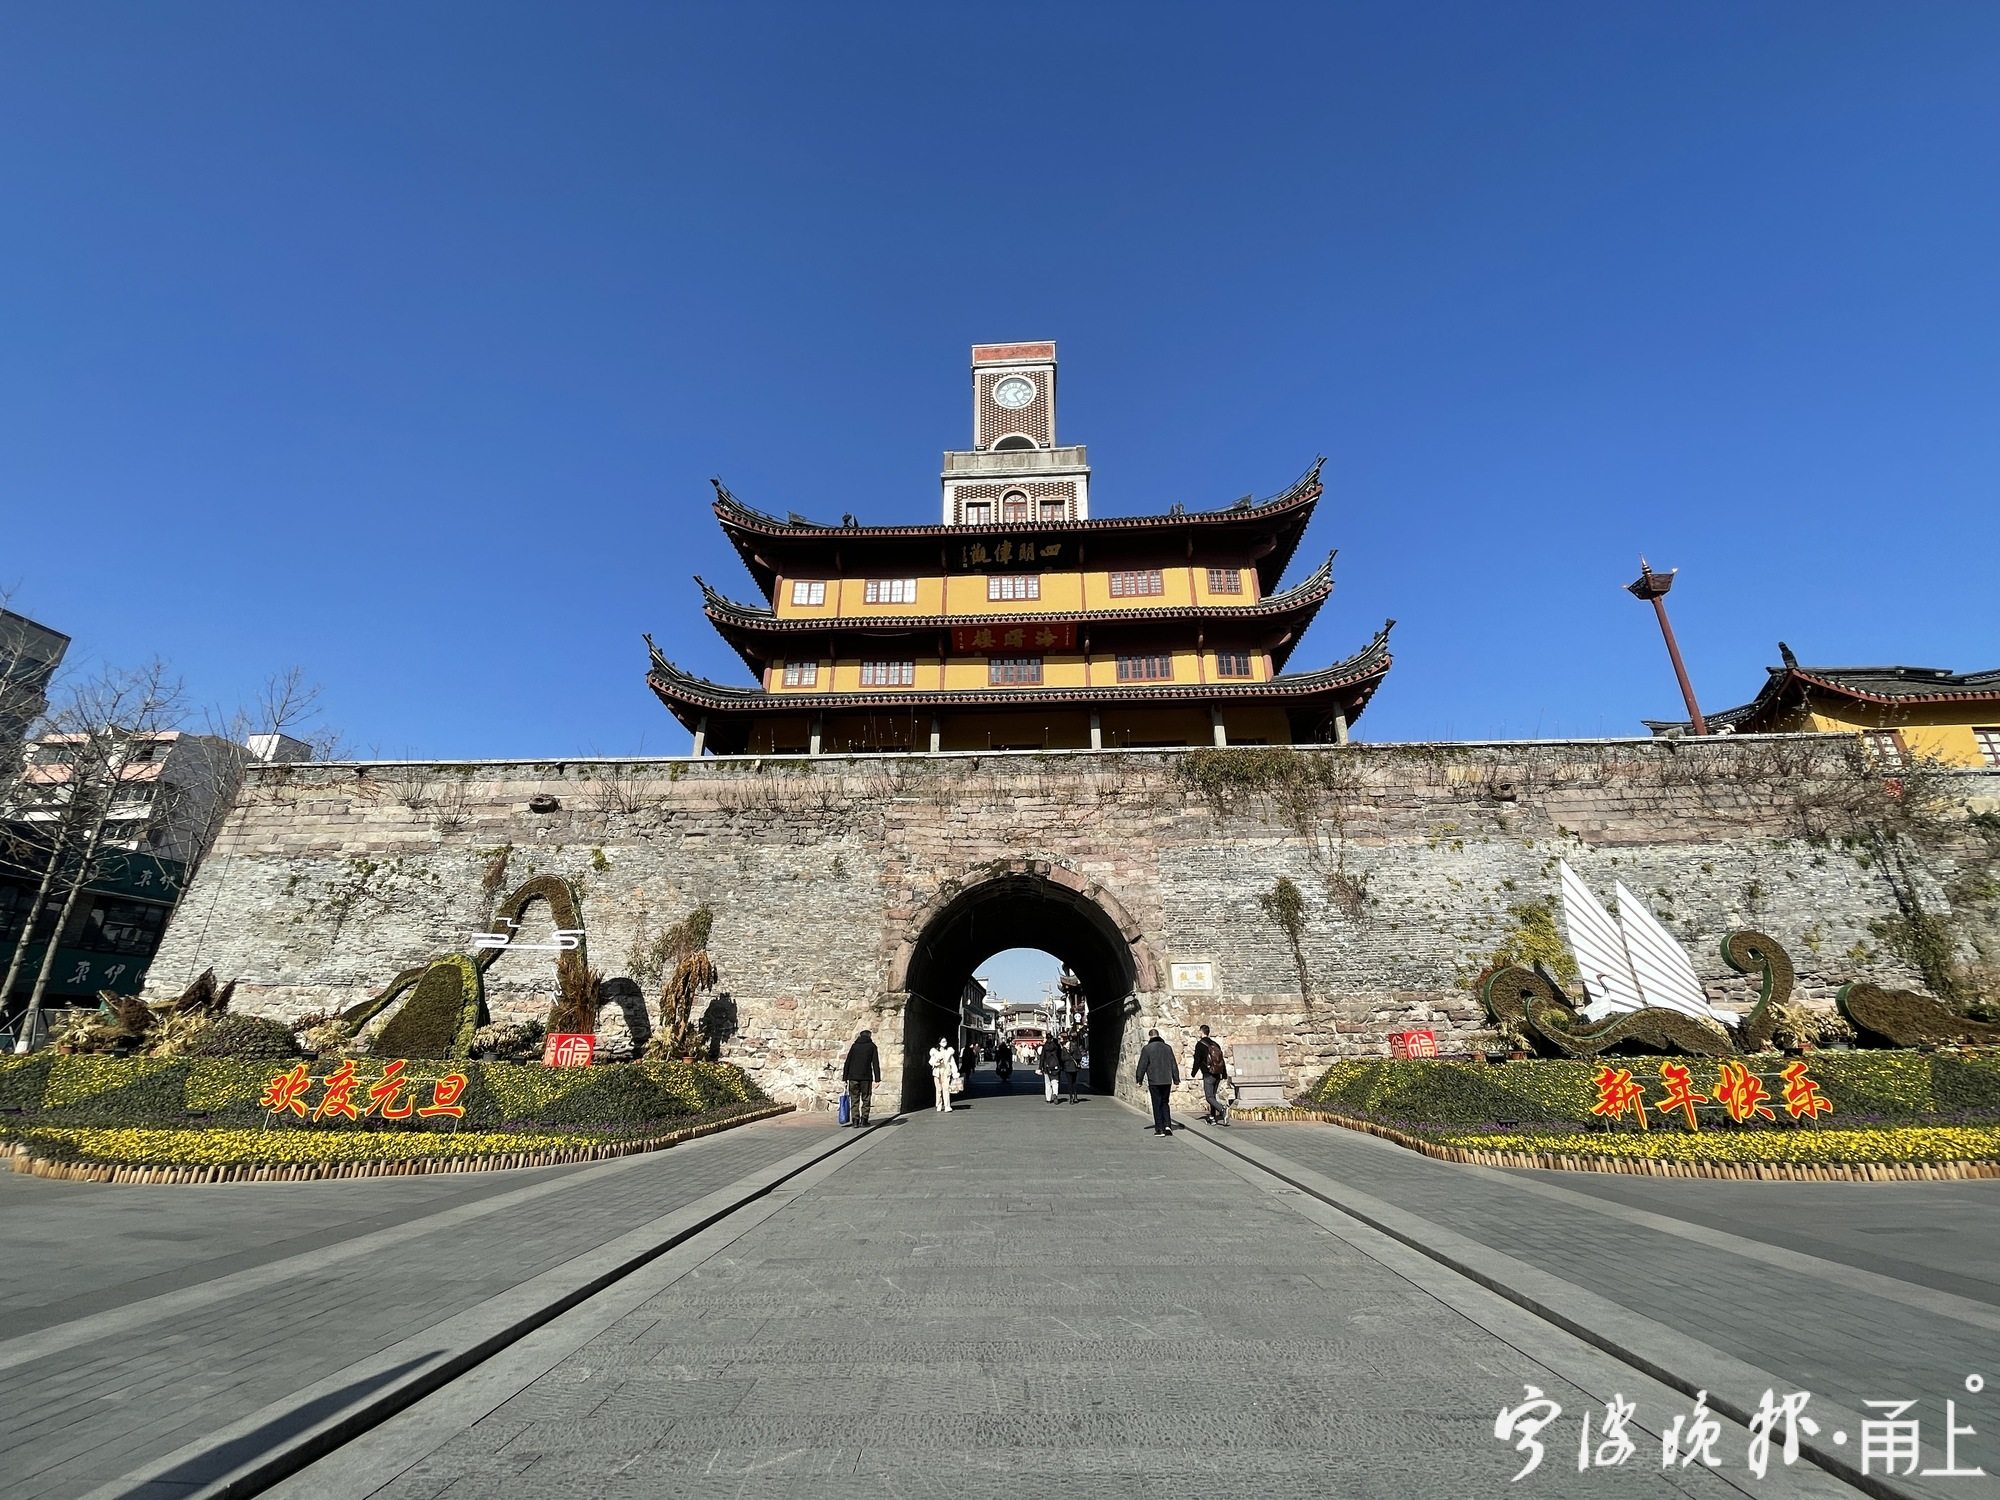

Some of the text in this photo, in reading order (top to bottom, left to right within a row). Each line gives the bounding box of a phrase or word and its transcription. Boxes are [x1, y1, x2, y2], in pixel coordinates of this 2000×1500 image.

[557, 1037, 591, 1067] 福
[260, 1059, 469, 1123] 欢度元旦
[1591, 1060, 1834, 1131] 新年快乐
